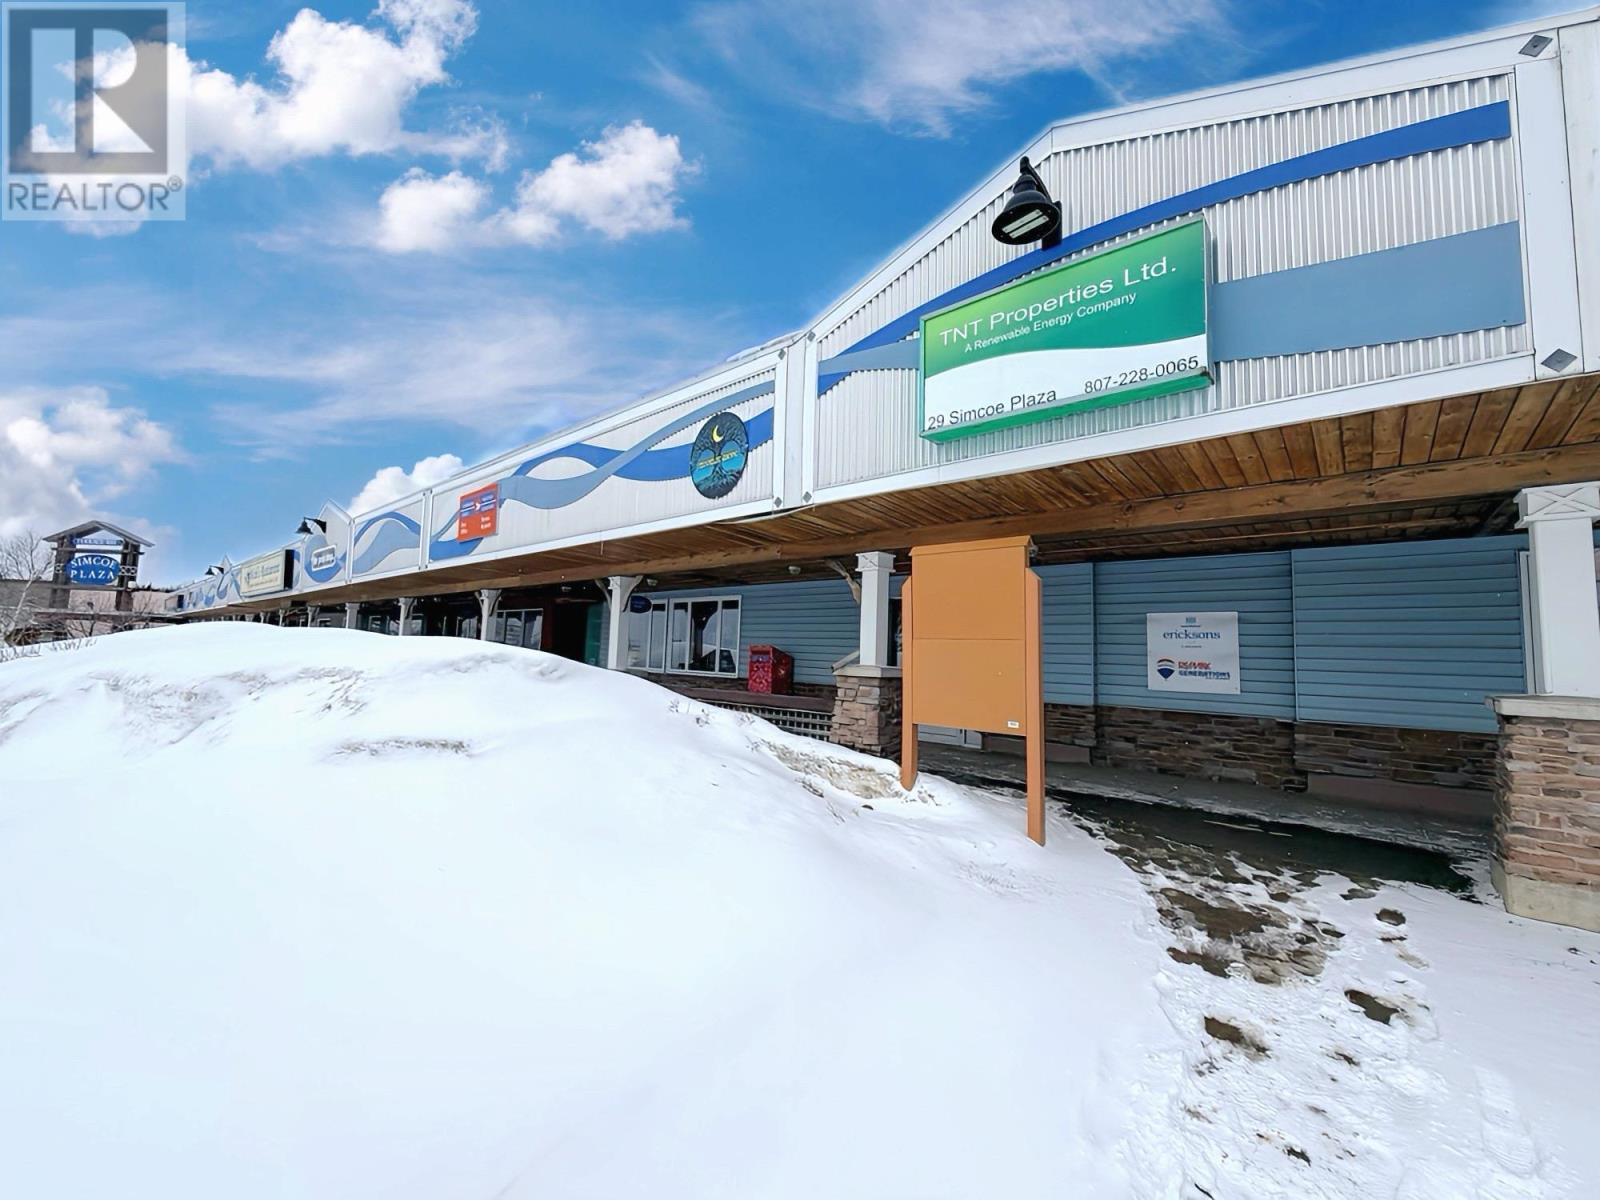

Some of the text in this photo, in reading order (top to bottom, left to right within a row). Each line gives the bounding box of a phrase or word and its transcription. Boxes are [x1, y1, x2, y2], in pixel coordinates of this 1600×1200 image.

[939, 256, 1177, 347] TNT Properties Ltd.
[964, 293, 1137, 353] A Renewable Energy Company
[927, 355, 1199, 431] 29 Simcoe Plaza 807-228-0065
[70, 556, 116, 570] SIMCOE
[70, 569, 115, 580] PLAZA
[1163, 629, 1221, 640] ericksons
